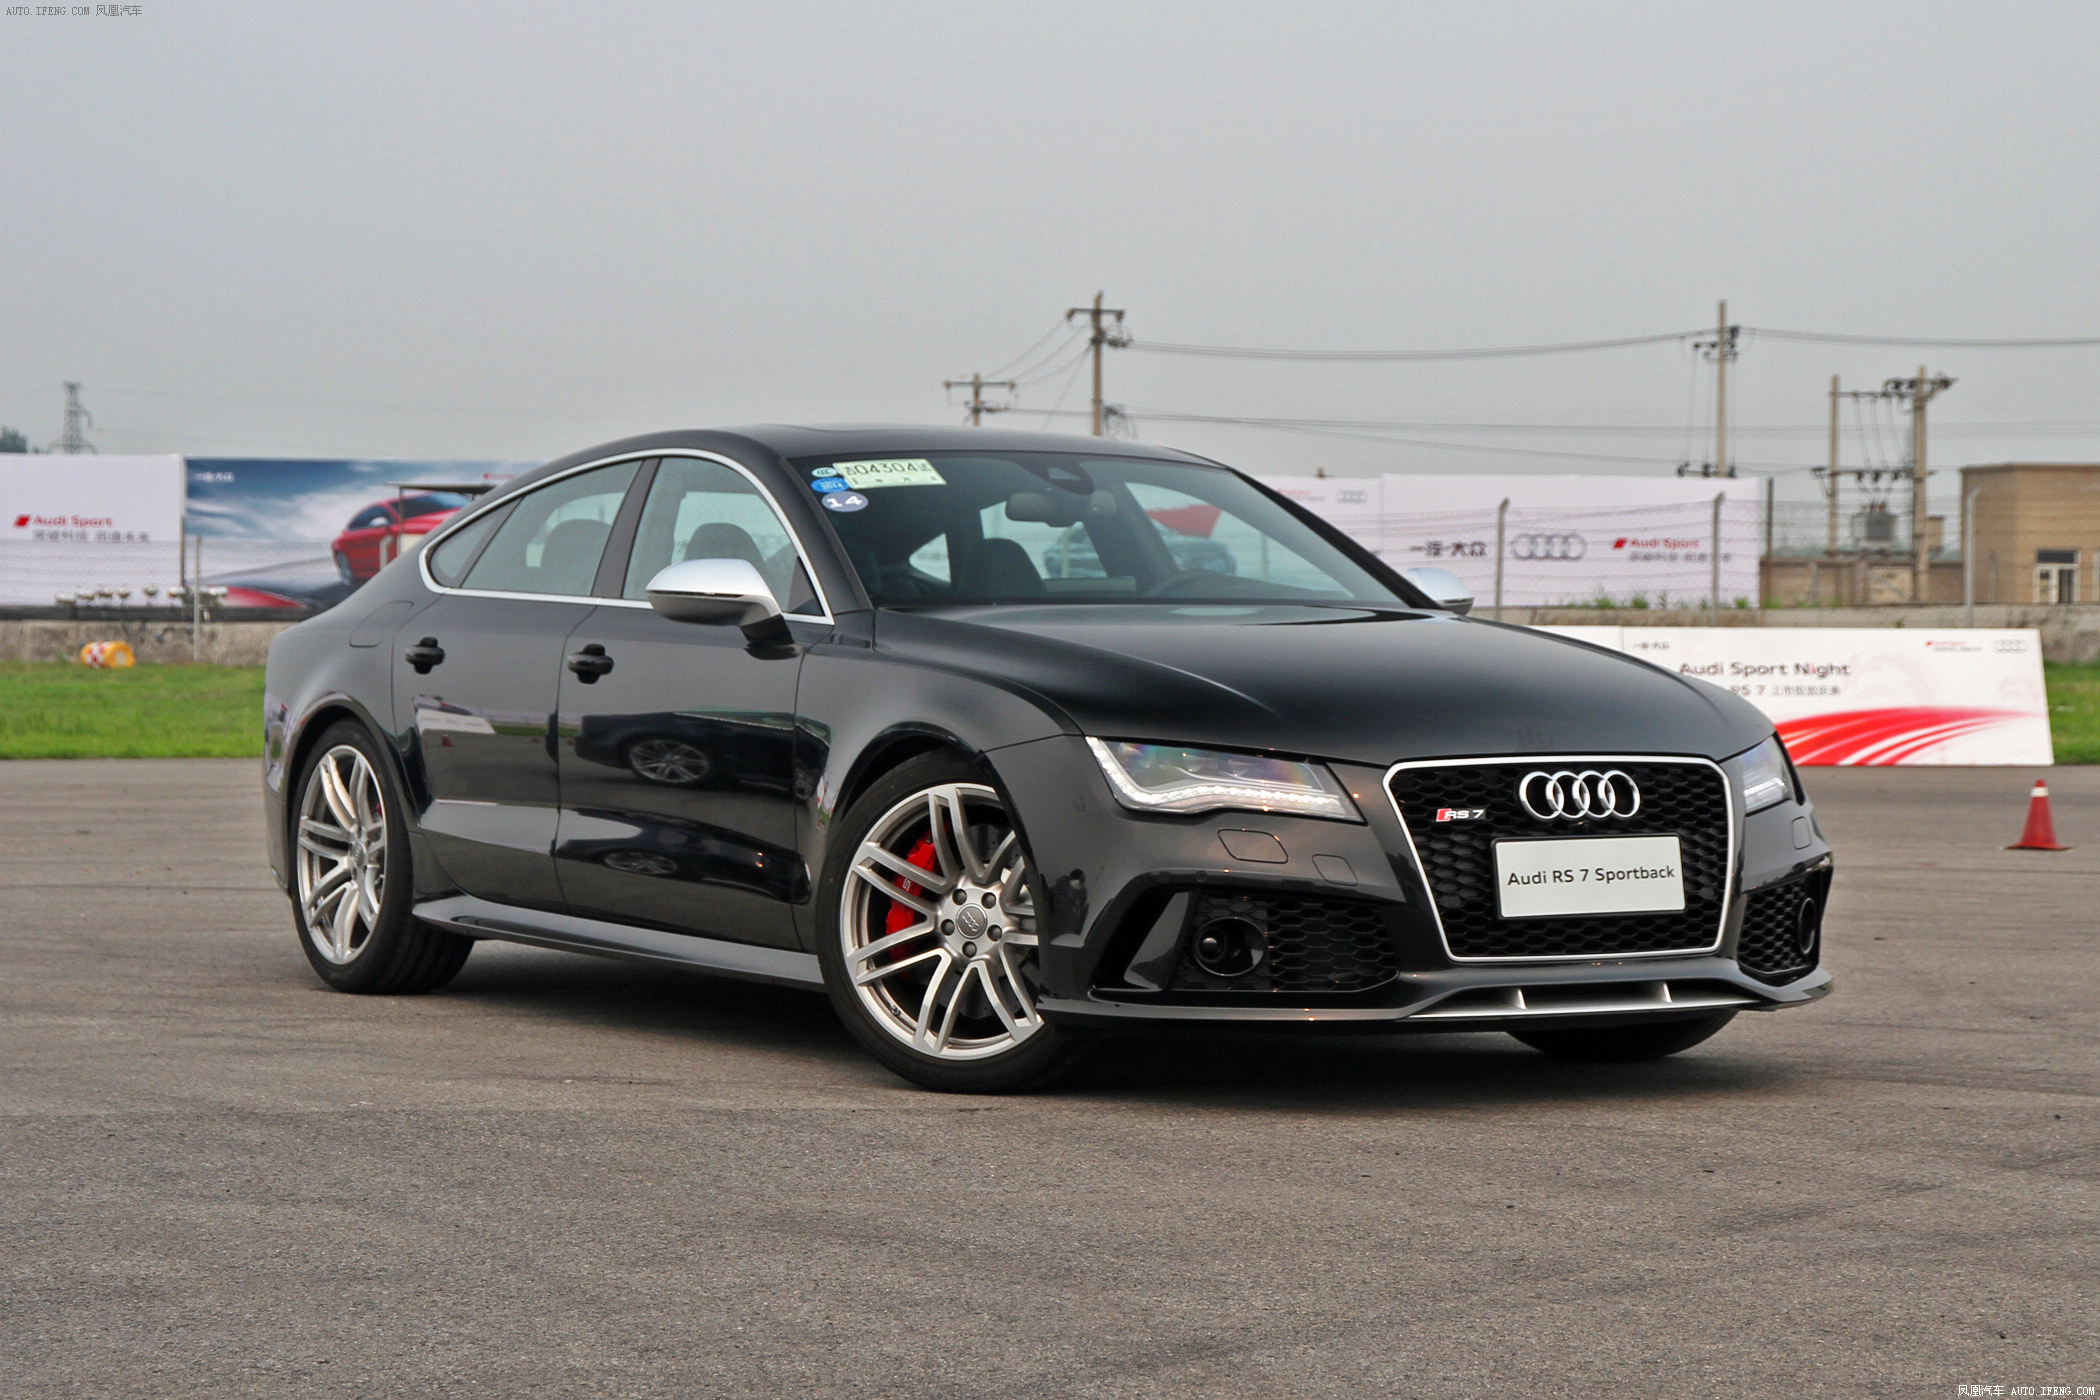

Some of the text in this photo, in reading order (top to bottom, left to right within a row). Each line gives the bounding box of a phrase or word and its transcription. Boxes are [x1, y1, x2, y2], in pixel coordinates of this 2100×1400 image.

[854, 461, 918, 475] 04304
[34, 515, 113, 527] Audi Sport
[1630, 538, 1700, 550] Audi Sport
[1679, 662, 1851, 678] Audi Sport Night
[1756, 685, 1766, 696] 7
[1443, 809, 1485, 820] RS 7
[1507, 865, 1676, 886] Audi RS 7 Sportback
